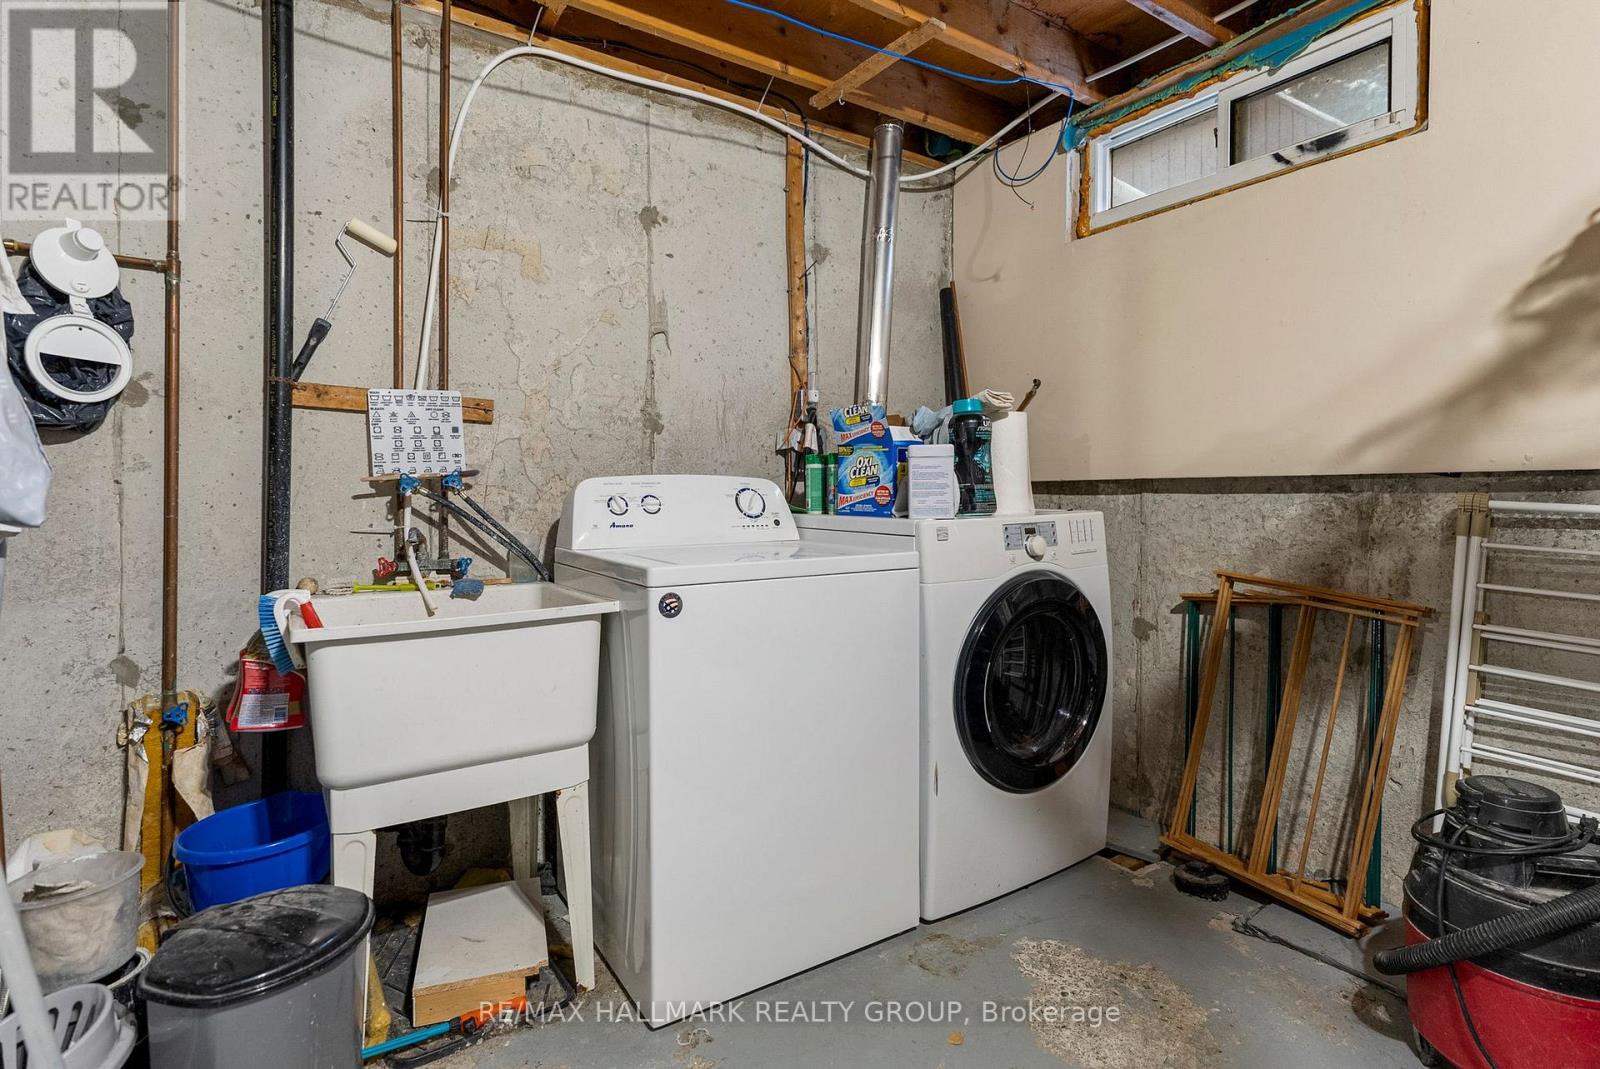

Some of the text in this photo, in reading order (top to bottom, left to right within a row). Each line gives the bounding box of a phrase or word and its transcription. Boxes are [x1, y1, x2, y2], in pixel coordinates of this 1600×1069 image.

[844, 404, 868, 417] CLEAN
[856, 456, 873, 468] OXI
[850, 464, 878, 478] CLEAN
[838, 495, 853, 507] MAX
